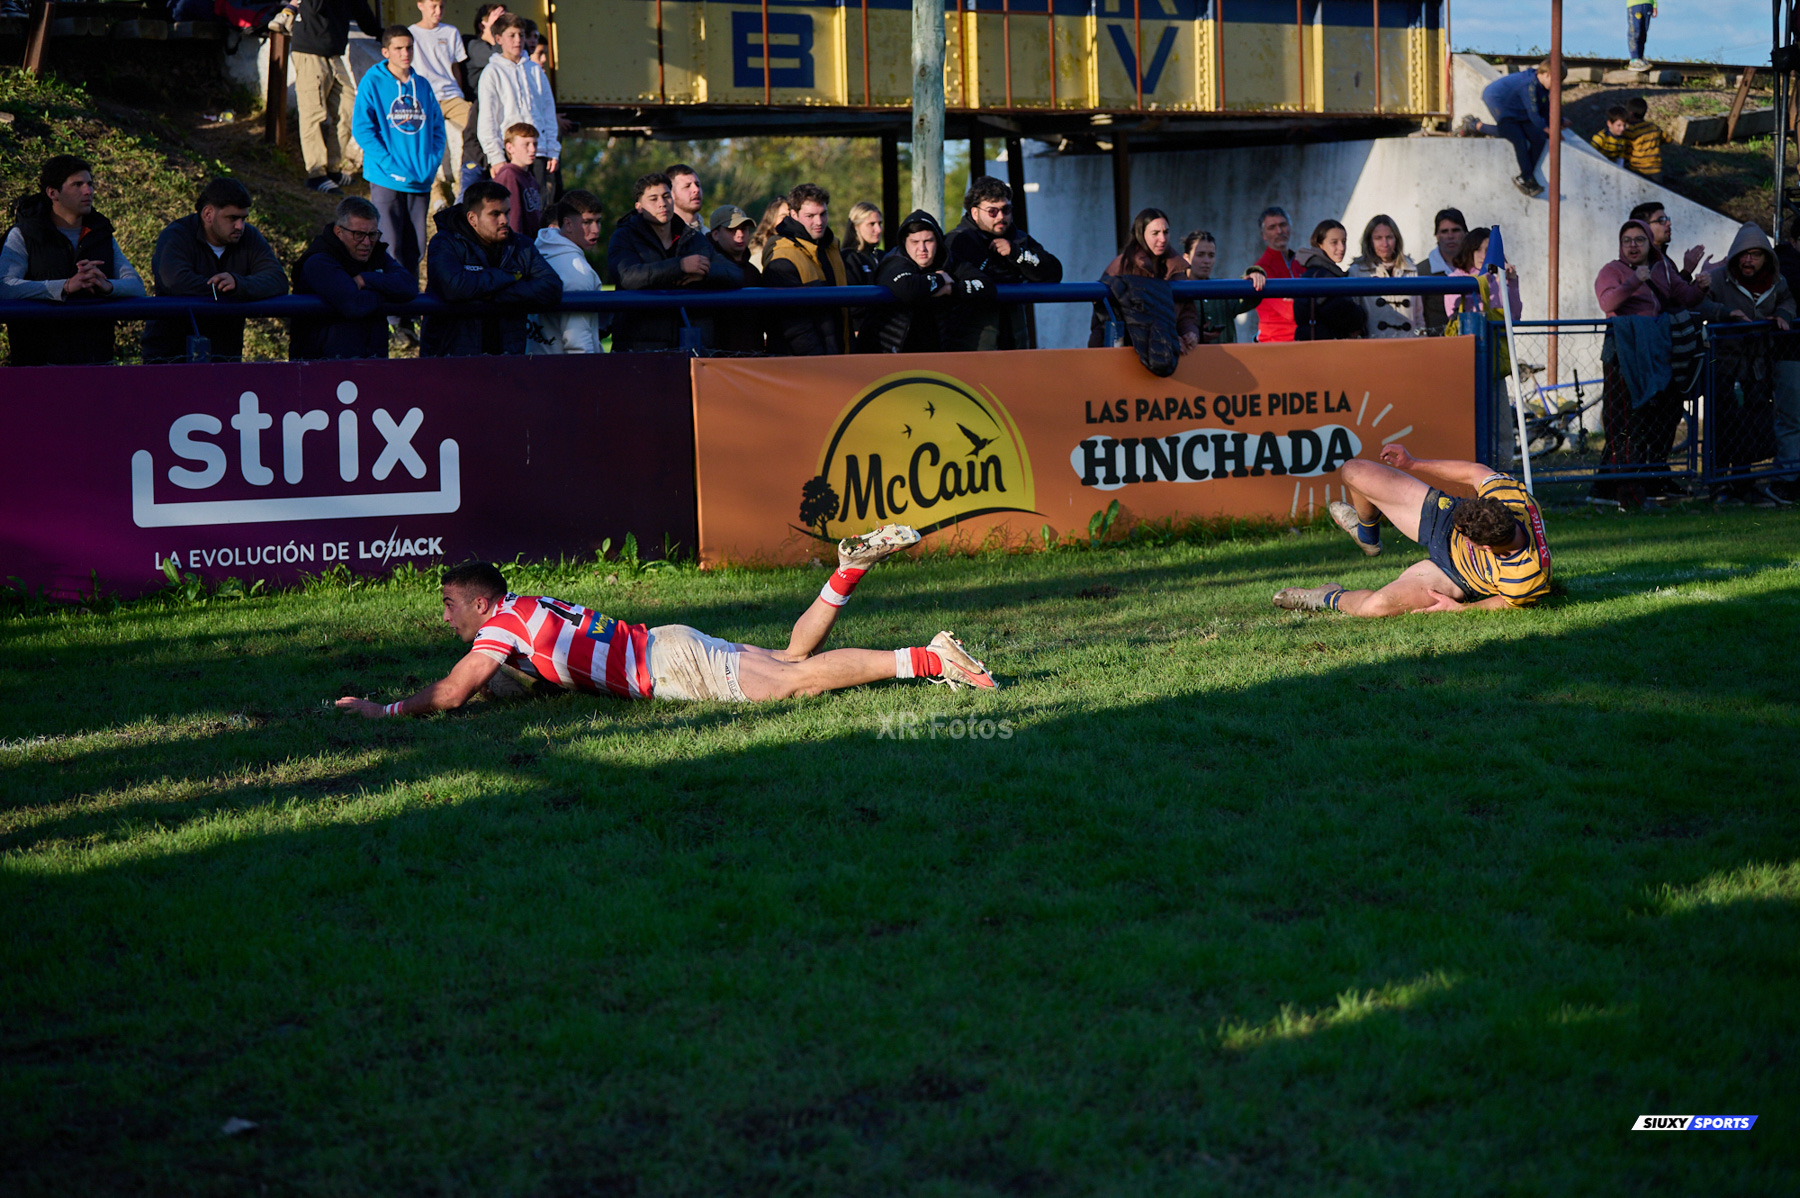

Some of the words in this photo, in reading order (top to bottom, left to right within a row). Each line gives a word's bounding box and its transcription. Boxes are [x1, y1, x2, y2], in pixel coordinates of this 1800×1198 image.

[731, 11, 815, 88] B
[1106, 24, 1180, 95] V
[168, 380, 427, 490] strix
[1085, 399, 1129, 424] LAS
[1135, 395, 1207, 422] PAPAS
[1212, 394, 1262, 425] QUE
[1268, 391, 1319, 416] PIDE
[1324, 390, 1352, 414] LA
[838, 441, 1007, 522] McCain
[1080, 428, 1354, 486] HINCHADA
[155, 550, 182, 571] LA
[189, 540, 315, 569] EVOLUCIÓN
[322, 541, 350, 561] DE
[358, 535, 444, 560] LOJACK
